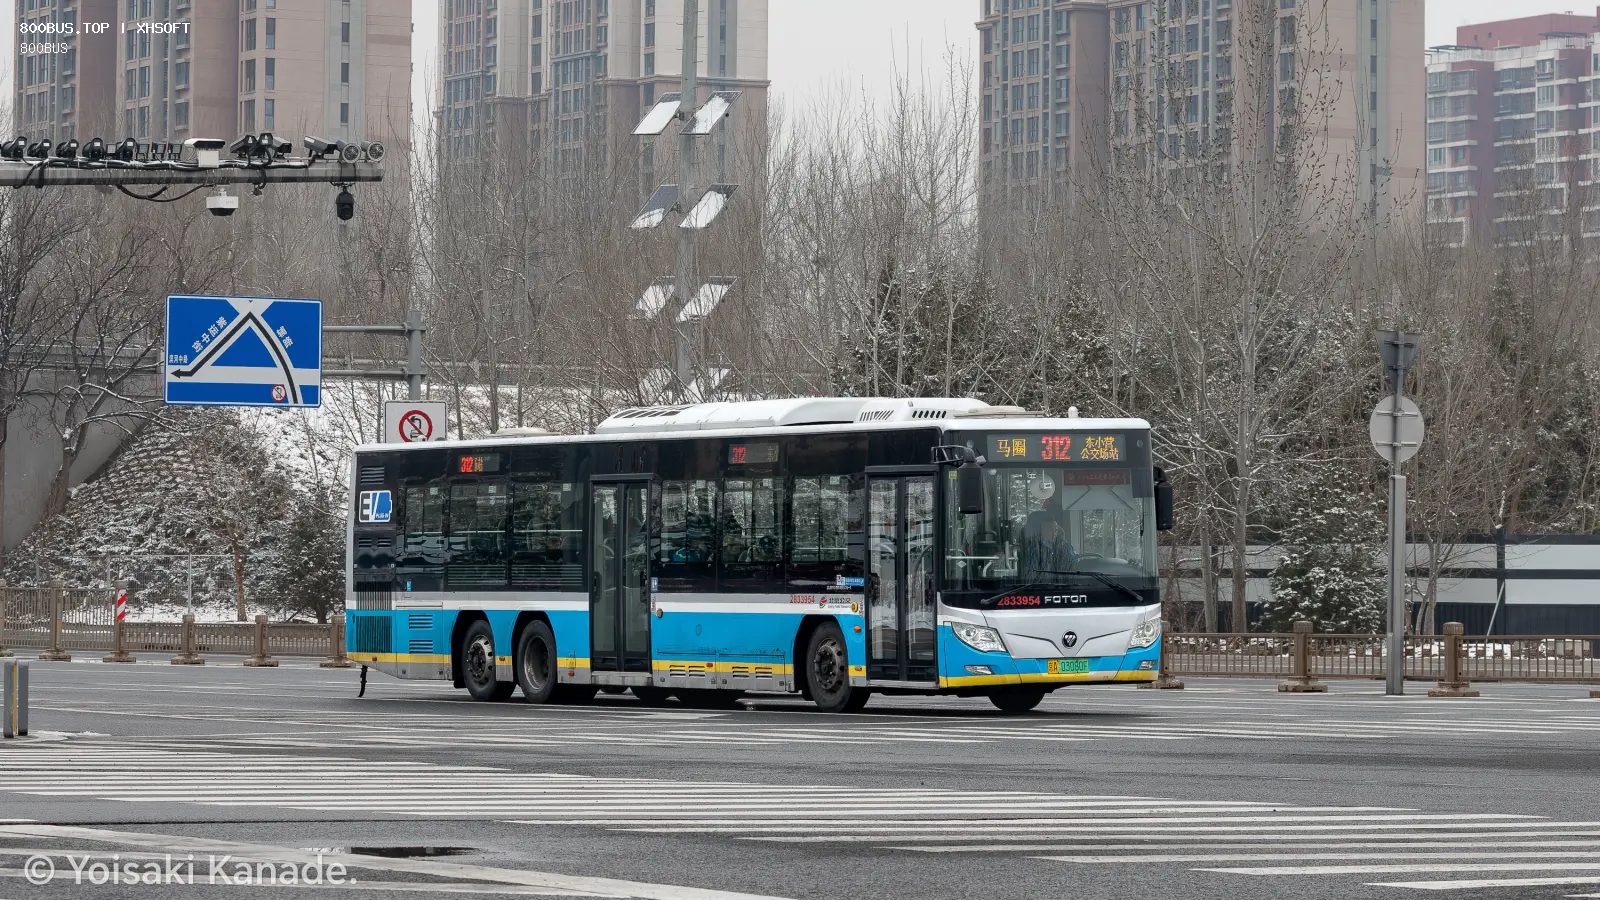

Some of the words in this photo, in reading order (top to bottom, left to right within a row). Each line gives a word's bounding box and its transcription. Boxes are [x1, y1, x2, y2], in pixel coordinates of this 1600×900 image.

[996, 438, 1027, 458] 马圈
[1041, 435, 1071, 460] 312
[1085, 436, 1115, 449] 东小营
[731, 446, 747, 464] 312
[1080, 447, 1119, 460] 公交场站
[460, 456, 474, 473] 312
[789, 594, 815, 604] 2833954
[997, 595, 1040, 607] 2833954
[1044, 594, 1087, 604] FOTON
